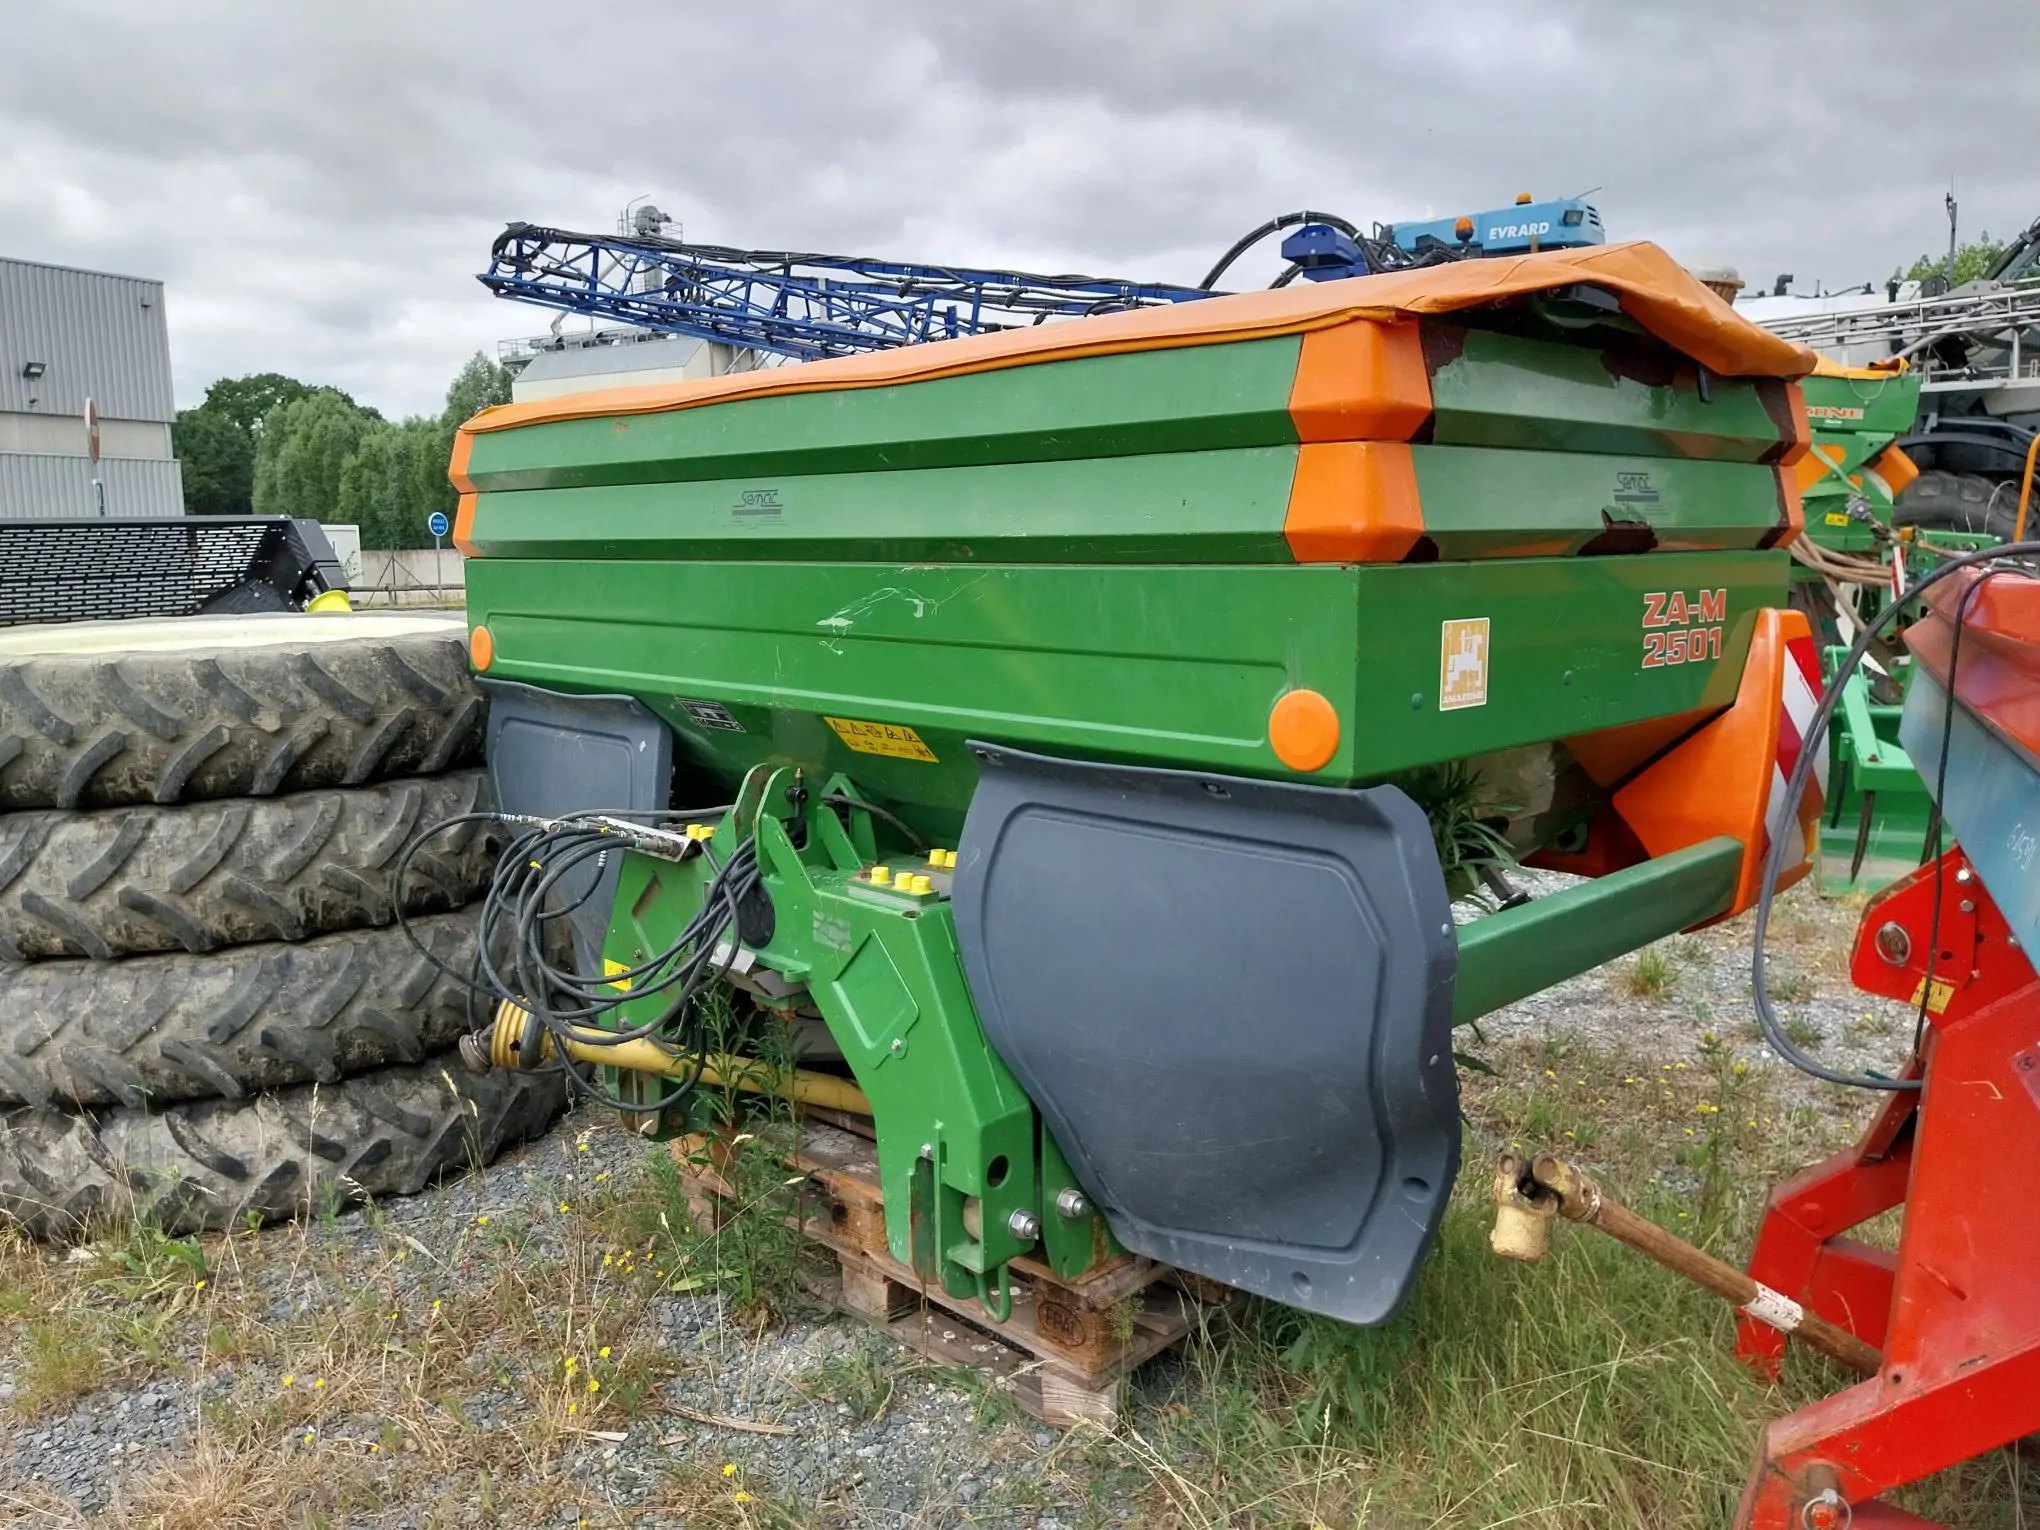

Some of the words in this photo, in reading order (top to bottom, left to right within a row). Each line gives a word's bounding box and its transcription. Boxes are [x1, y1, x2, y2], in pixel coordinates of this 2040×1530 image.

[1489, 222, 1550, 240] EVRARD
[1642, 588, 1728, 627] ZA-M
[1641, 626, 1724, 667] 2501
